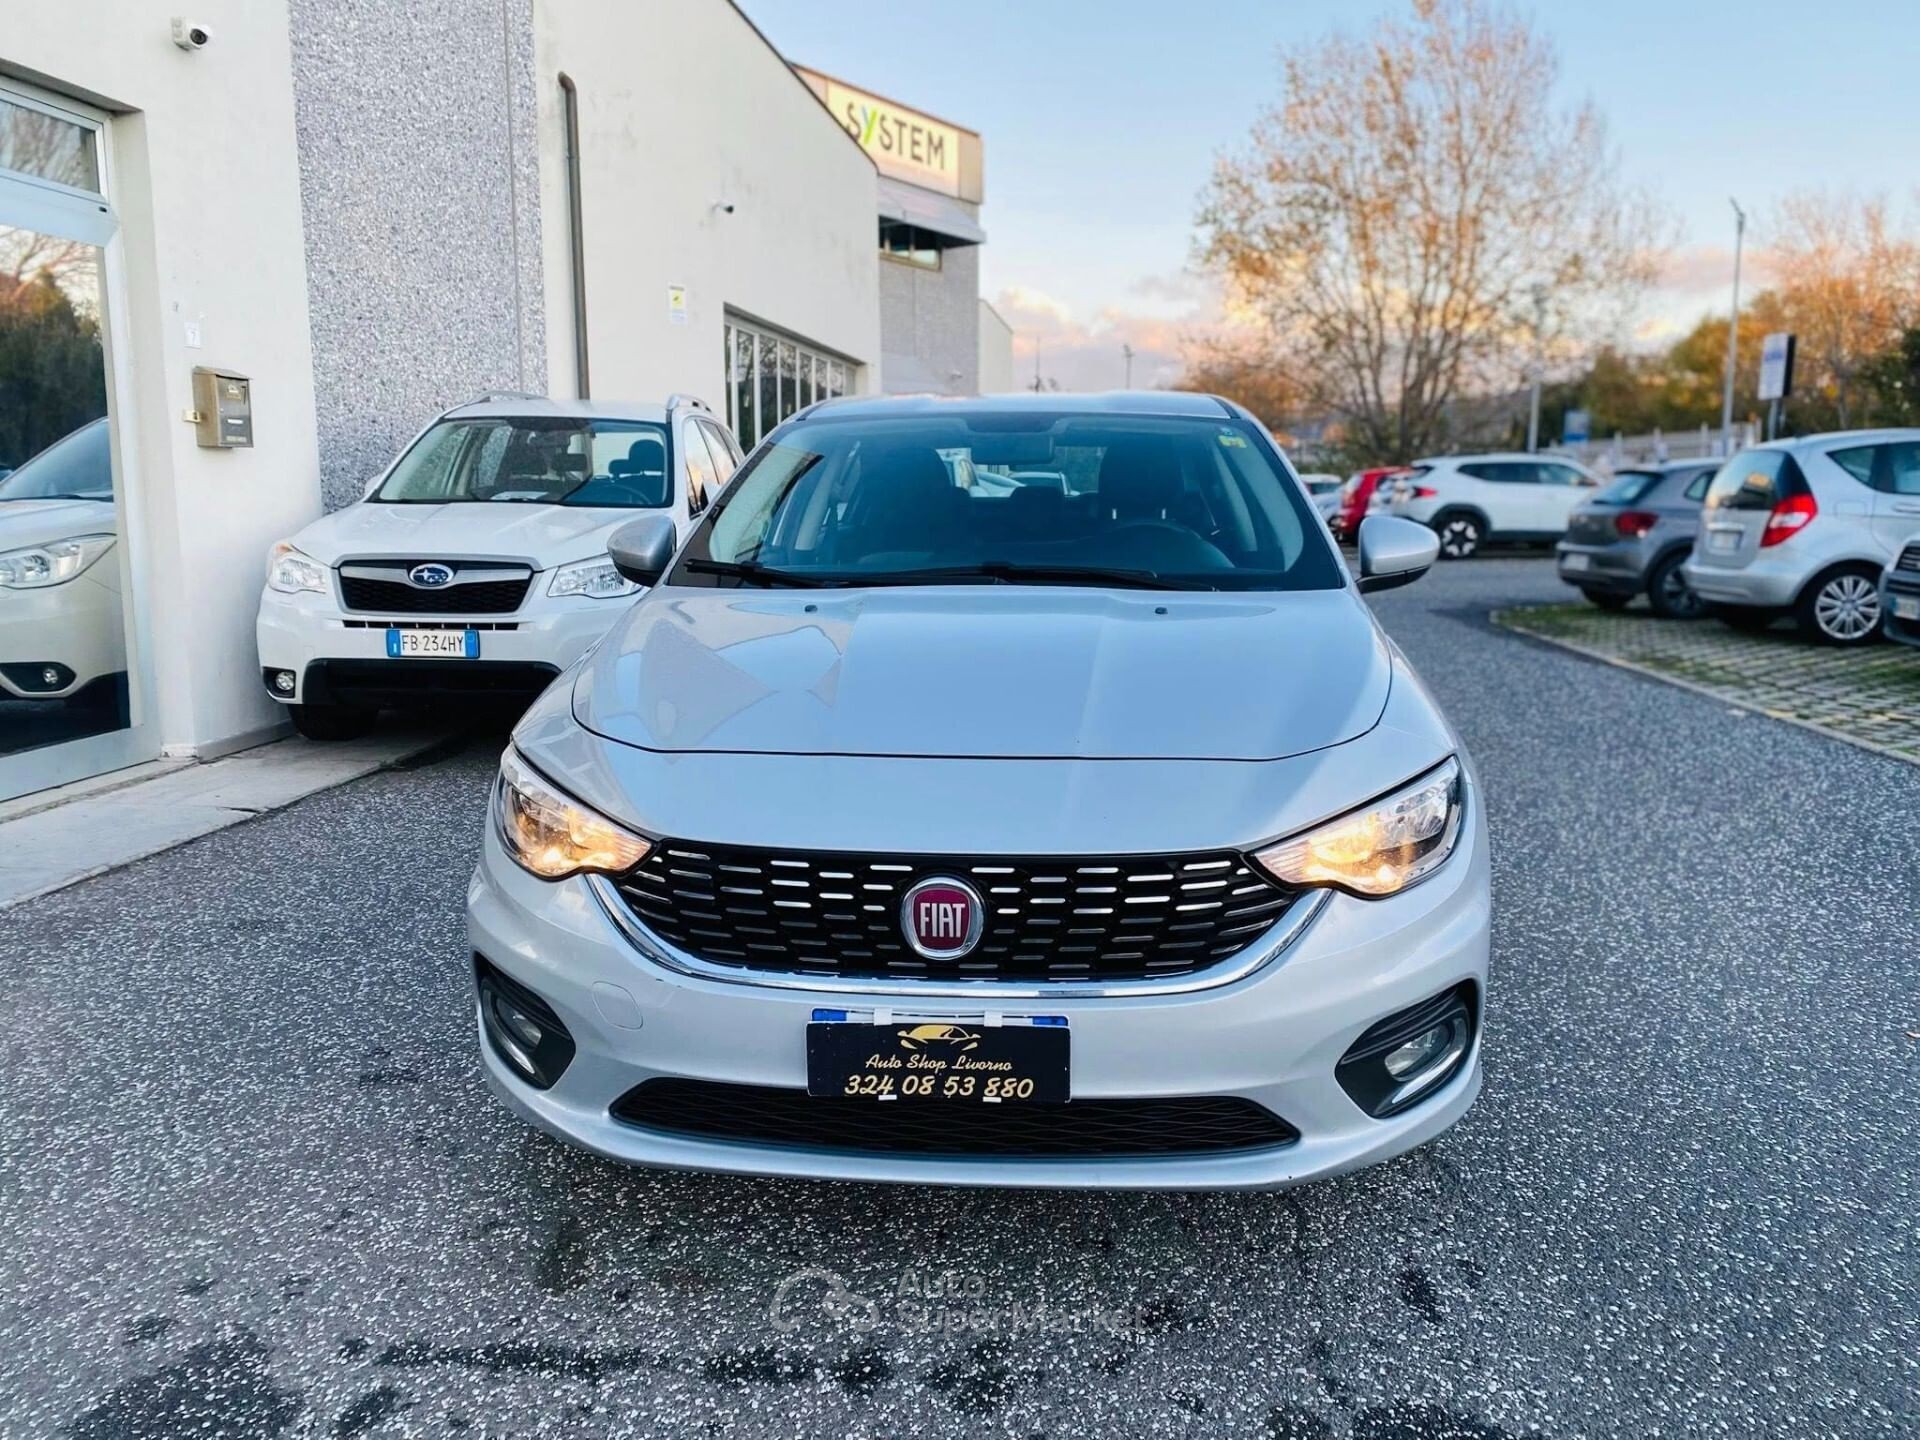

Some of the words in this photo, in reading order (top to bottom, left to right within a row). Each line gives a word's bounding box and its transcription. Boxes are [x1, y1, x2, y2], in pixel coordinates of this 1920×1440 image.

[846, 101, 945, 170] SYSTEM
[920, 902, 966, 938] FIAT
[865, 1053, 902, 1068] Auto
[906, 1053, 947, 1073] Shop
[951, 1055, 1012, 1071] Livorno
[844, 1074, 894, 1094] 324
[902, 1075, 935, 1095] 08
[943, 1075, 976, 1096] 53
[983, 1077, 1034, 1098] 880
